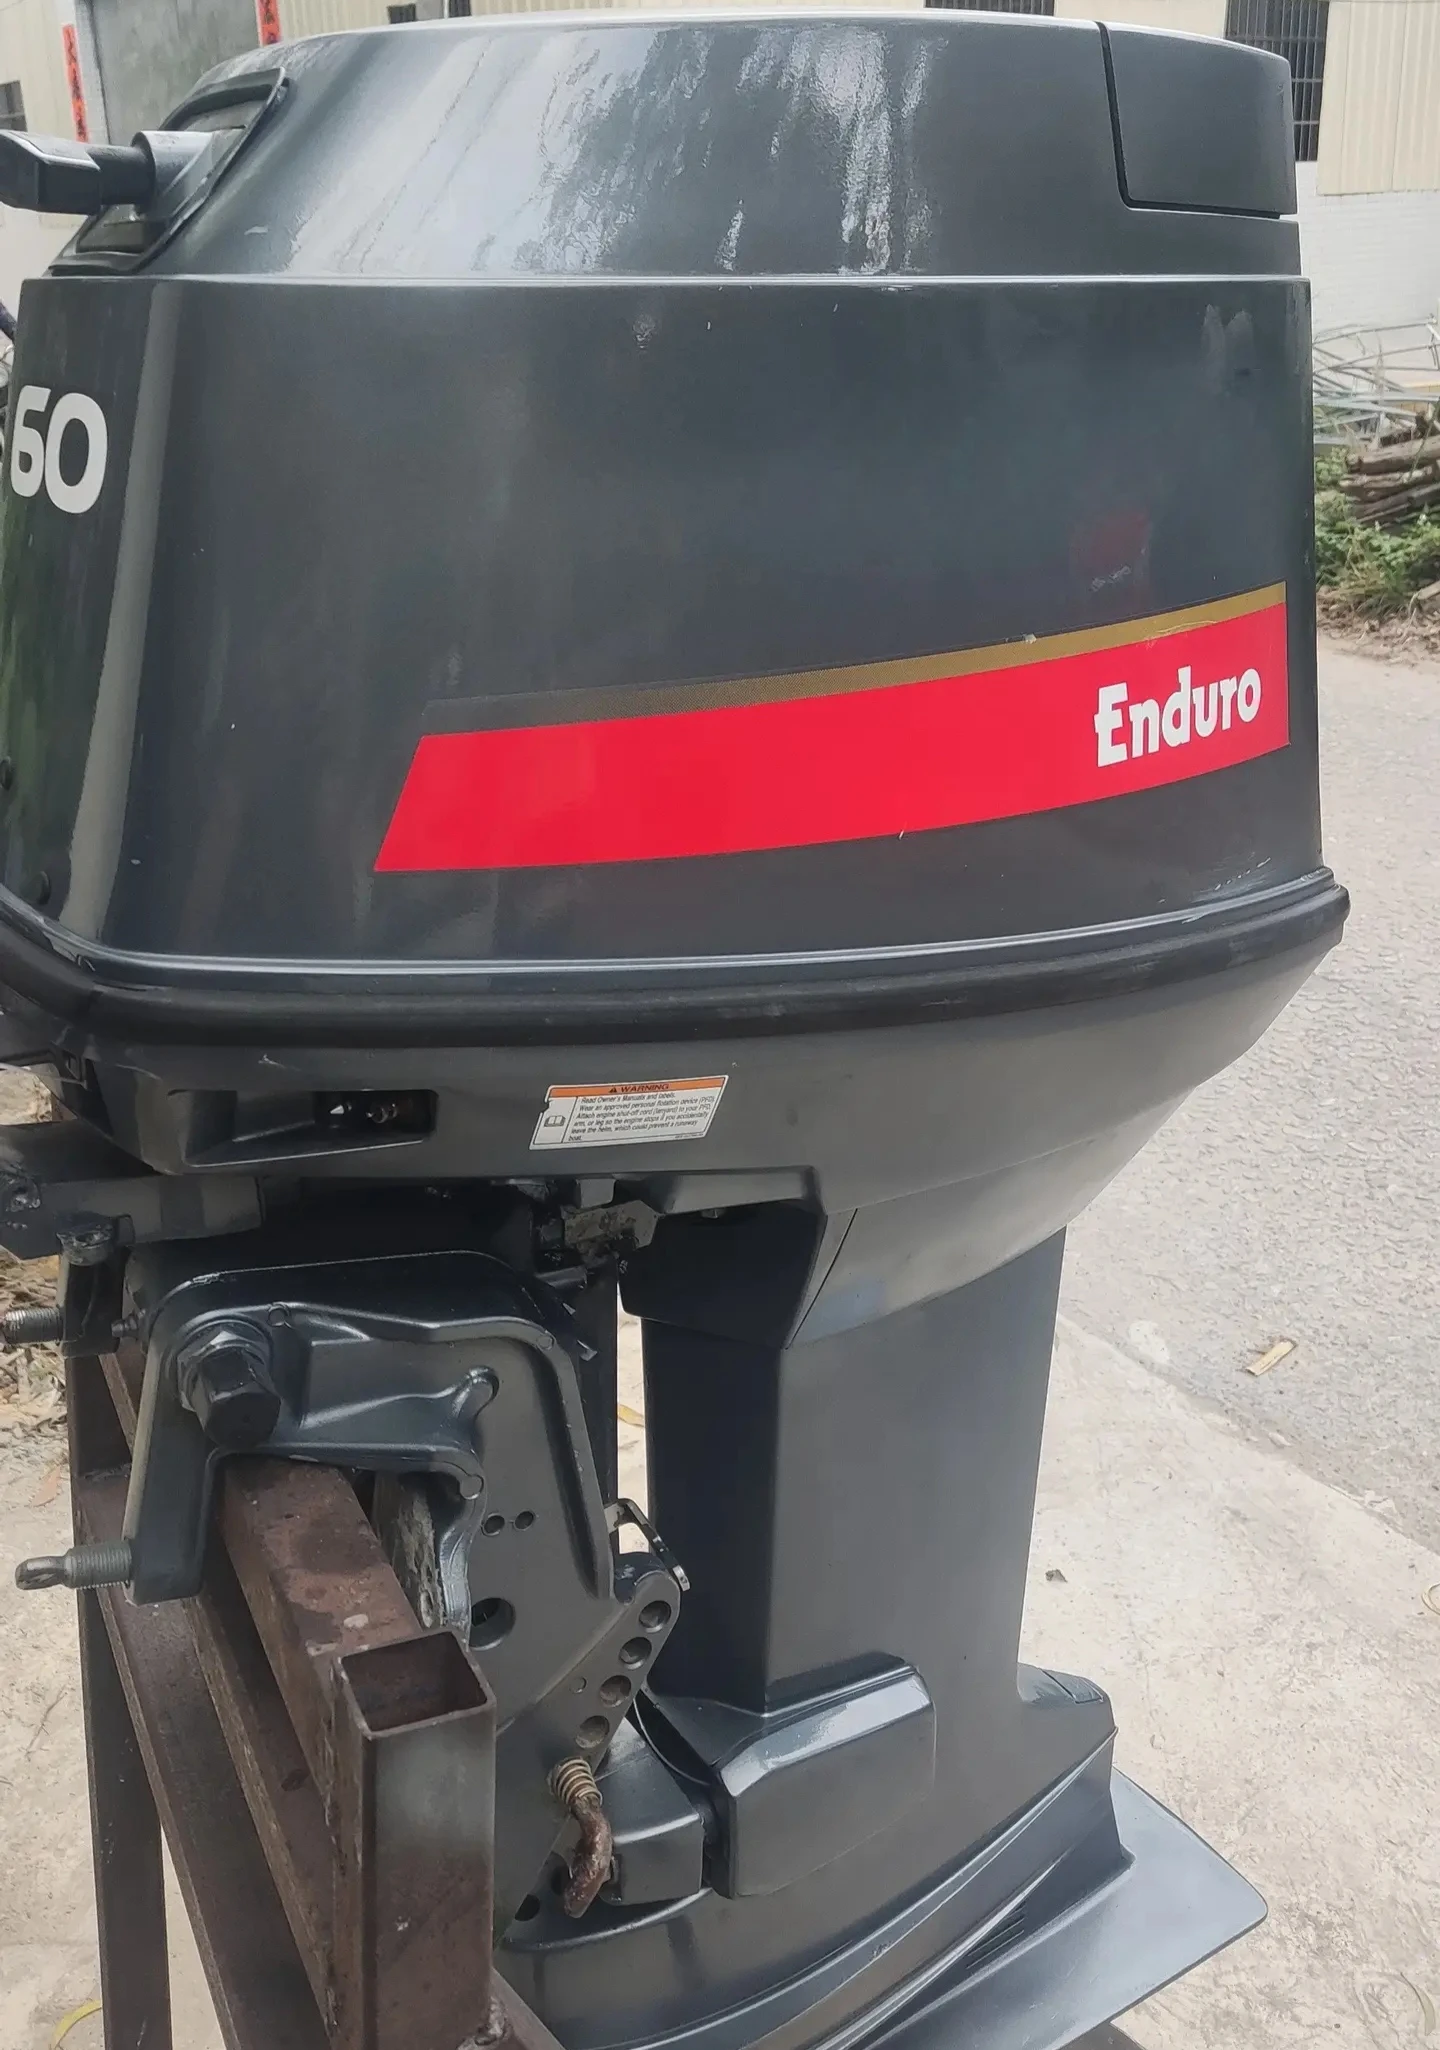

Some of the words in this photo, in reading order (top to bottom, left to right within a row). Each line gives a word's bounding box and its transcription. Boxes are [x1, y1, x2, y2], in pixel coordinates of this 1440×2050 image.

[10, 385, 108, 514] 60
[1093, 665, 1261, 768] Enduro
[621, 1084, 669, 1092] WARNING
[604, 1103, 630, 1111] approved
[631, 1101, 656, 1109] personal
[680, 1097, 699, 1105] device
[685, 1105, 698, 1113] your
[623, 1117, 643, 1125] engine
[665, 1114, 676, 1122] you
